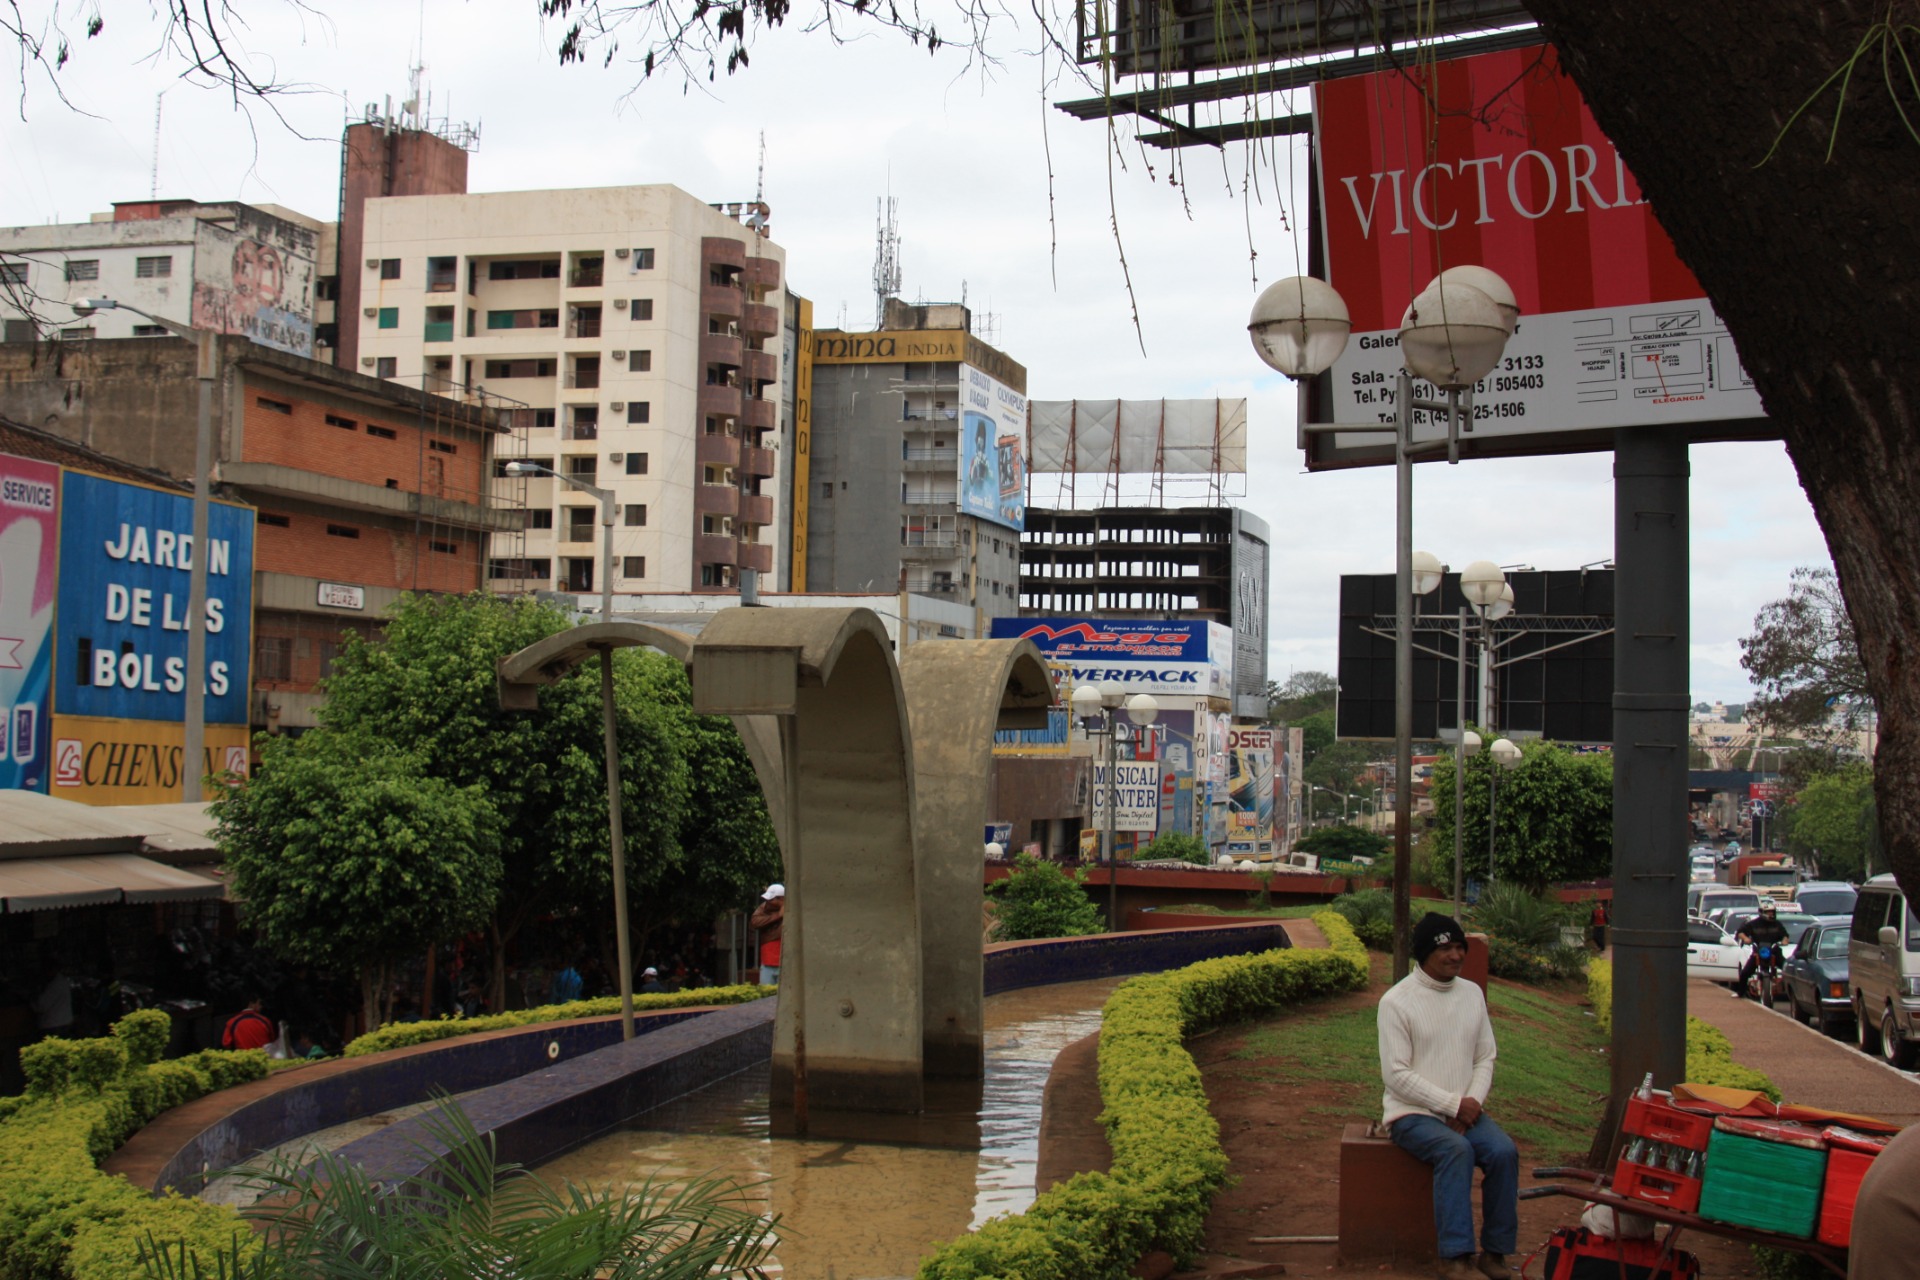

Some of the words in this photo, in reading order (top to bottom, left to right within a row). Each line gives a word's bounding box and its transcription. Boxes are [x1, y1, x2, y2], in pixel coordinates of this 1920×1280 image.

[1341, 141, 1649, 240] VICTORI
[907, 342, 956, 357] INDIA
[1359, 334, 1401, 350] Galer
[1504, 355, 1544, 371] 3133
[1581, 359, 1611, 367] SHOPPING
[1351, 370, 1385, 385] Sala
[1496, 374, 1544, 392] 505403
[997, 386, 1025, 414] OLYMPUS
[1354, 389, 1377, 404] Tel.
[1652, 394, 1705, 404] ELEGANCIA
[1412, 411, 1427, 424] R:
[1458, 401, 1525, 421] 25-1506
[3, 480, 52, 507] SERVICE
[105, 522, 230, 576] JARDN
[105, 582, 152, 627] DE
[1018, 622, 1192, 645] Mega
[1056, 643, 1183, 652] ELETRÔNICOS
[94, 648, 230, 697] BOLSS
[1053, 669, 1199, 684] OWERPACK
[1229, 731, 1272, 749] OSTER
[84, 741, 221, 789] CHENSN
[1095, 766, 1157, 786] MSICAL
[1095, 788, 1156, 808] CNTER
